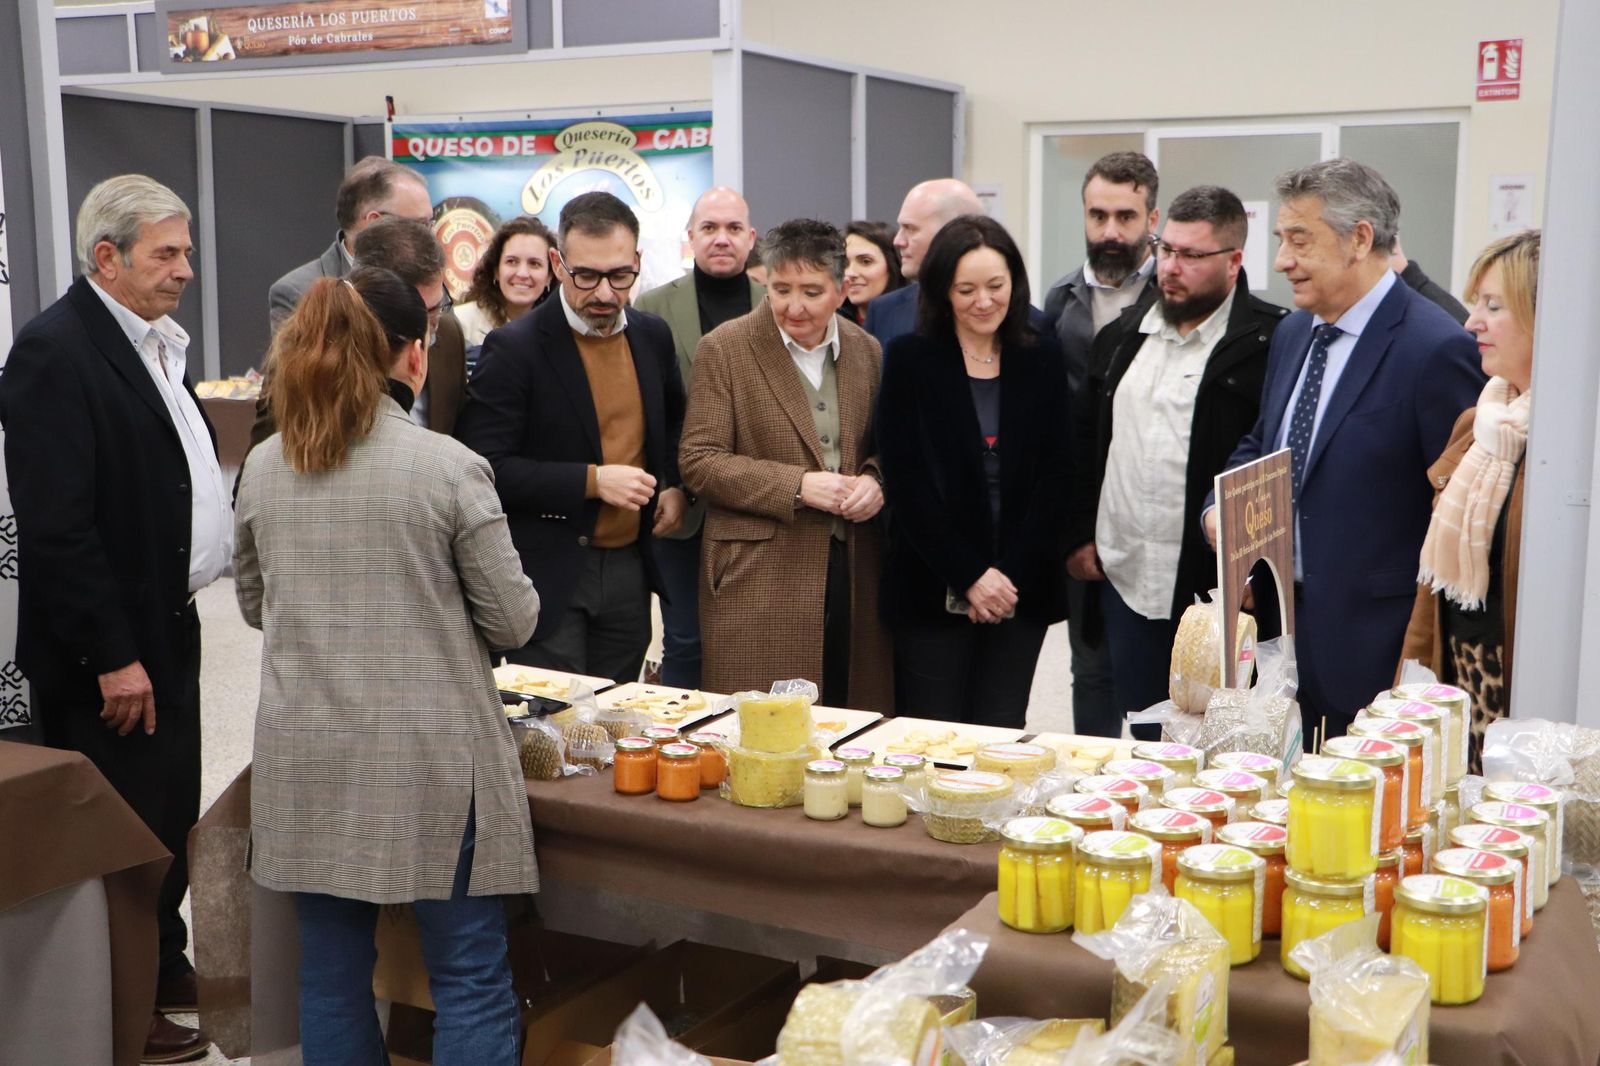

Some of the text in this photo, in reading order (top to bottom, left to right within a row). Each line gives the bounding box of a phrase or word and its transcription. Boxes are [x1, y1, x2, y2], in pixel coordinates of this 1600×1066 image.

[247, 8, 417, 33] QUESERÍA LOS PUERTOS
[288, 31, 374, 46] Póo de Cabrales
[1478, 87, 1519, 97] EXTINTOR
[408, 126, 713, 161] QUESO DE CAB
[562, 128, 632, 147] Quesería
[528, 148, 656, 204] Los Puertos
[1245, 501, 1272, 539] Queso
